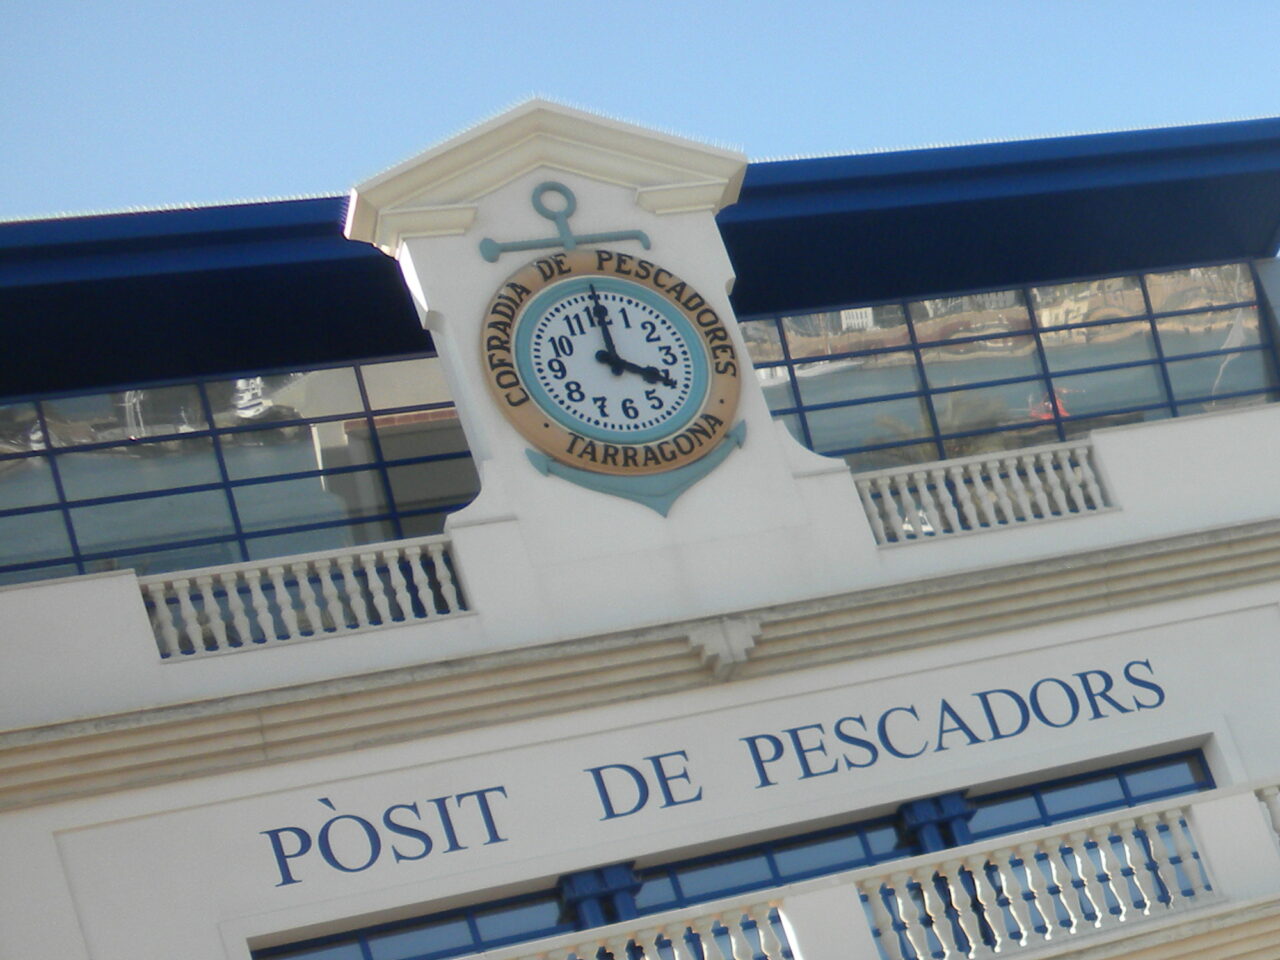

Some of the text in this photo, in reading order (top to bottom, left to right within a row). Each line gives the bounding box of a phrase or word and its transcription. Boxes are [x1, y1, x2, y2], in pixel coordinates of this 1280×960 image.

[486, 249, 737, 407] COFRADIA DE PESCADORES
[562, 312, 587, 336] 11
[618, 307, 632, 329] 1
[640, 320, 662, 343] 2
[548, 335, 574, 358] 10
[658, 345, 678, 366] 3
[547, 358, 567, 380] 9
[564, 381, 586, 403] 8
[645, 388, 664, 410] 5
[592, 396, 609, 418] 7
[621, 398, 639, 420] 6
[565, 412, 725, 468] TARRAGONA
[258, 658, 1167, 888] PÒSIT DE PESCADORS
